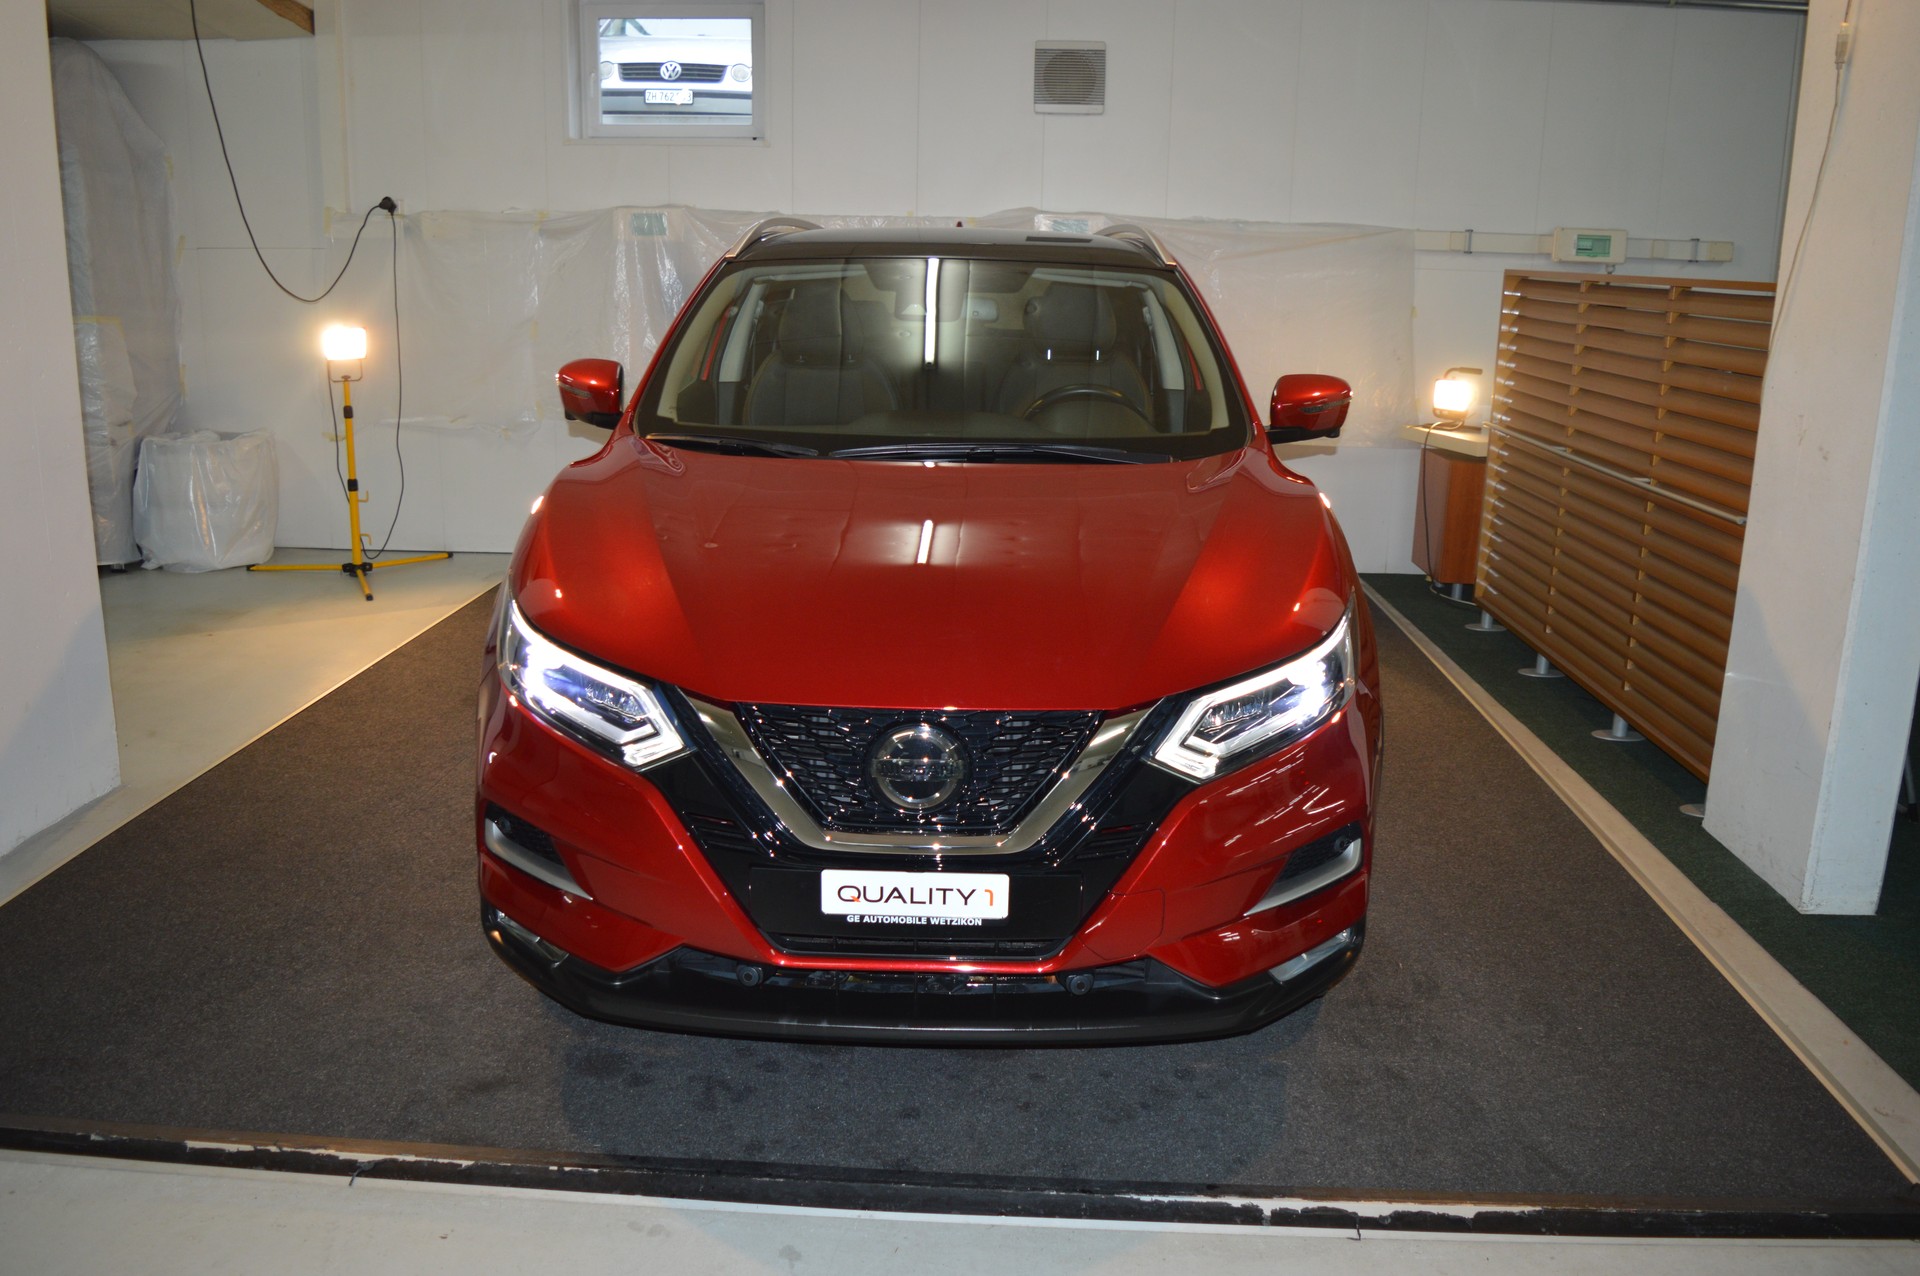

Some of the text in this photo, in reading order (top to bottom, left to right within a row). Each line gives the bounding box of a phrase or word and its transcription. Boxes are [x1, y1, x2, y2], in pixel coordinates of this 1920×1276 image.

[646, 91, 692, 102] ZH 7623
[837, 885, 994, 907] QUALITY 1
[846, 915, 983, 927] GE AUTOMOBILE WETZIKON
